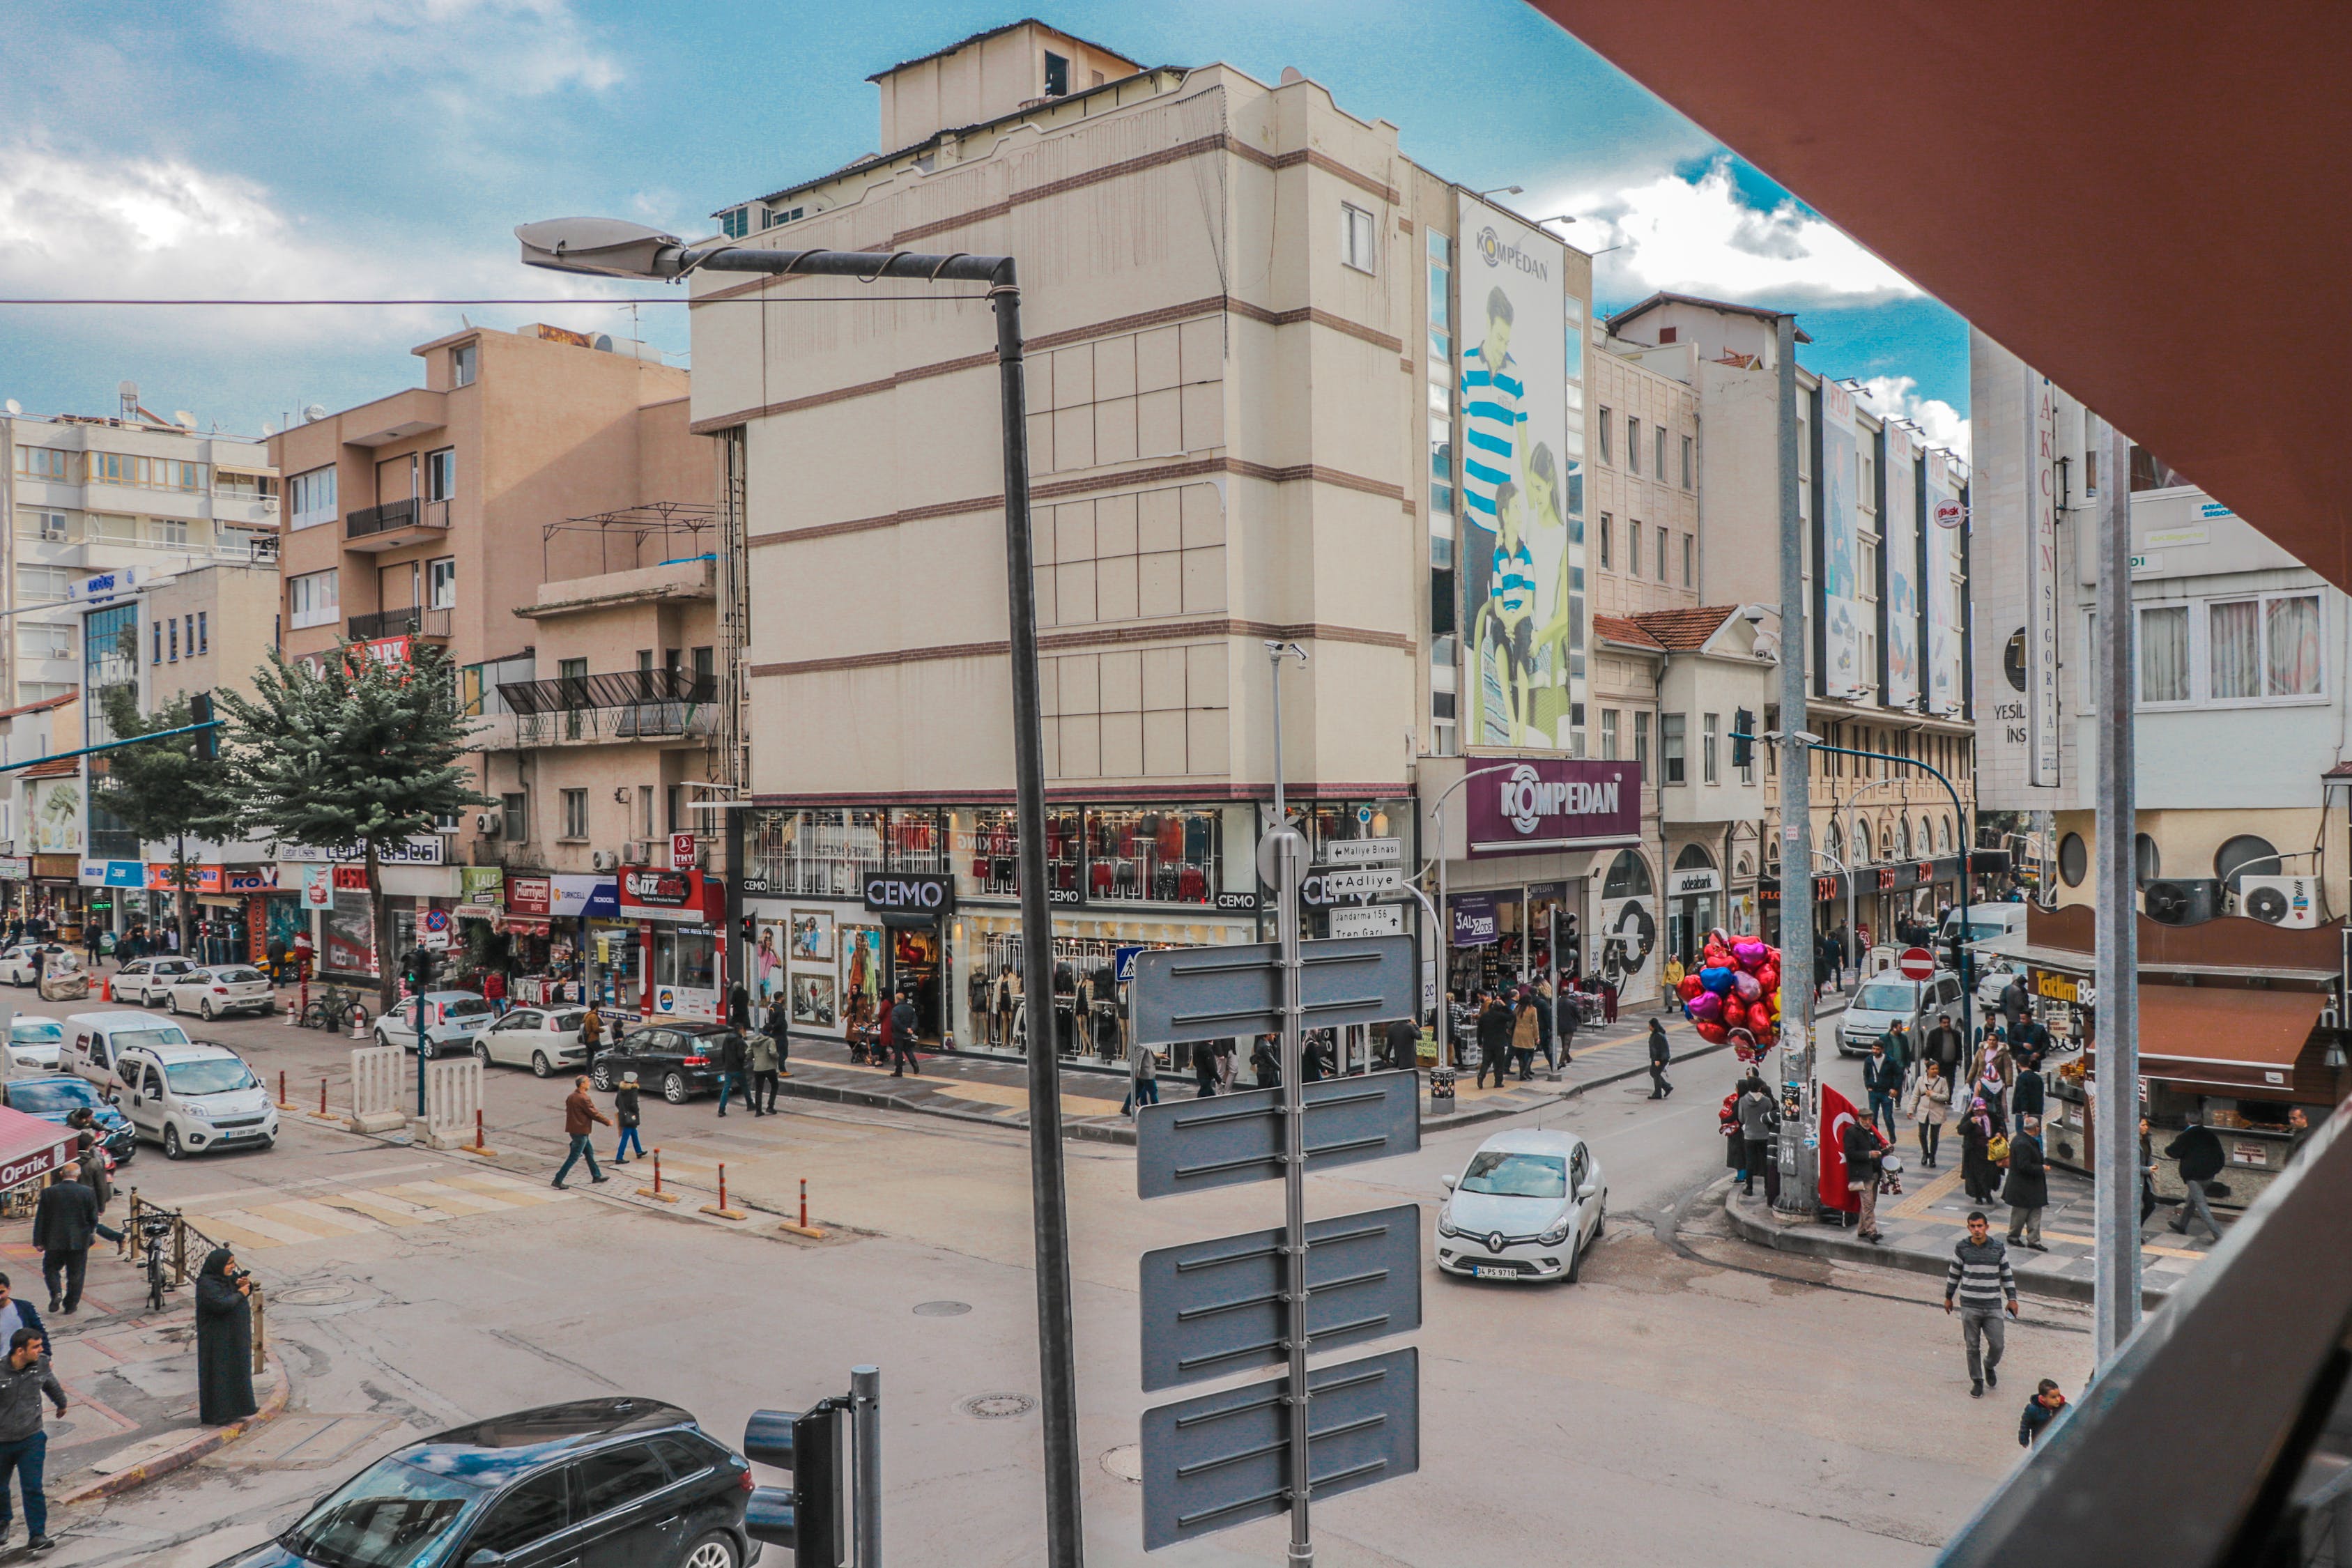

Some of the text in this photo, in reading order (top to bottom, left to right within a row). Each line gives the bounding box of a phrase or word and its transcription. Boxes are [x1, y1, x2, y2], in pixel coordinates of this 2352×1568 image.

[1477, 226, 1548, 282] KOMPEDAN
[1830, 387, 1850, 417] FLO
[1891, 428, 1907, 456] FLO
[2040, 393, 2053, 573] AKCAN
[1500, 776, 1618, 823] KOMPEDAN
[675, 854, 693, 862] THY
[1344, 845, 1397, 856] Maliye Binası
[1879, 868, 1895, 889] FLO
[1919, 861, 1933, 882] FLO
[744, 880, 767, 891] CEMO
[1346, 875, 1392, 888] Adliye
[1682, 874, 1712, 891] odeabank
[1817, 876, 1837, 901] FLO
[516, 883, 547, 900] Hürriyet
[561, 891, 585, 900] TURKCELL
[867, 879, 942, 907] CEMO
[1049, 890, 1079, 903] CEMO
[1217, 894, 1255, 908] CEMO
[1336, 909, 1388, 922] Jandarma 156
[1455, 912, 1474, 930] 3 AL
[1475, 919, 1480, 934] 2
[1, 1155, 49, 1184] OPTİK
[1498, 1269, 1515, 1277] 9716
